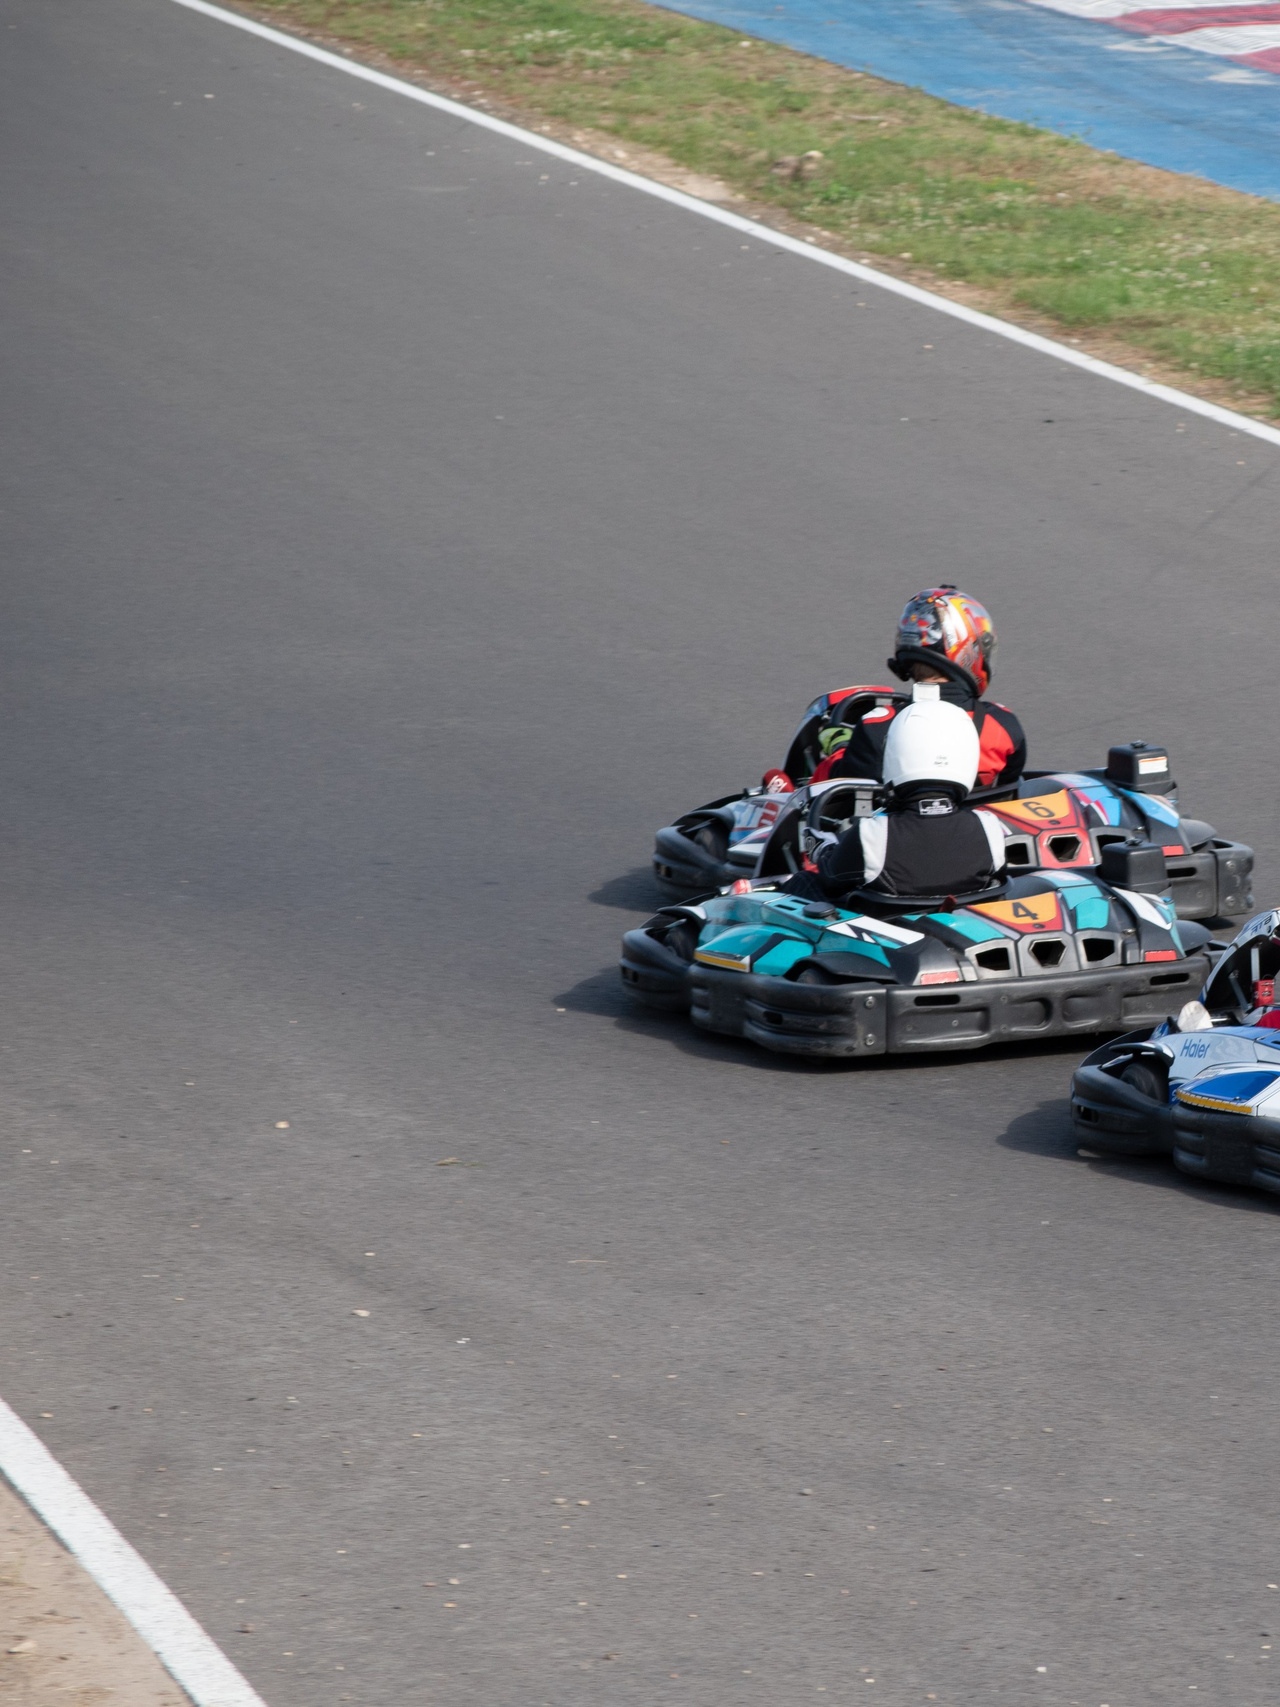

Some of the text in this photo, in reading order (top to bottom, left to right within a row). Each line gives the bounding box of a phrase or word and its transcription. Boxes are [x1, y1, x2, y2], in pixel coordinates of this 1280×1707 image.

[1022, 801, 1055, 818] 6
[1012, 902, 1039, 920] 4
[1180, 1038, 1211, 1059] Haier
